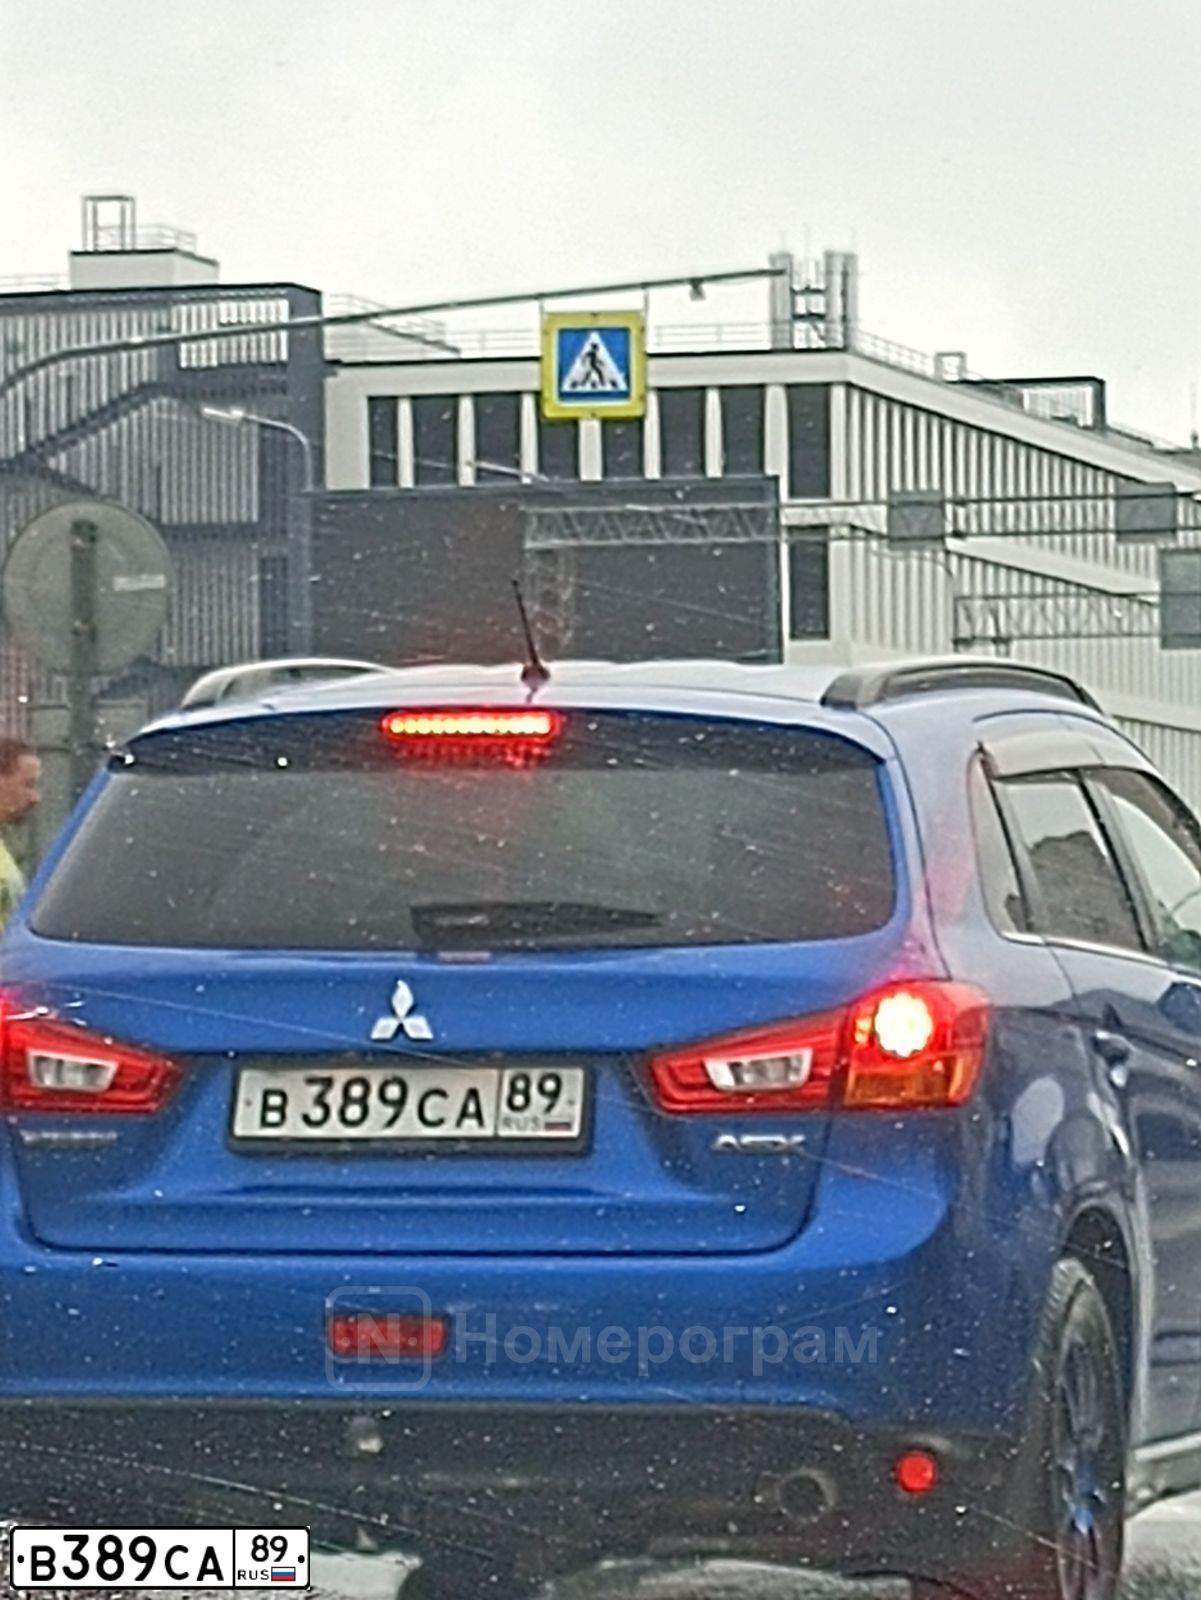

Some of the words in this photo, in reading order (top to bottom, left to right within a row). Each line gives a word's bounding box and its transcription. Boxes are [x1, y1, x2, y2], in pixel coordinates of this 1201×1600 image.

[260, 1075, 485, 1128] В389СА
[506, 1072, 563, 1113] 89
[502, 1117, 541, 1129] RUS
